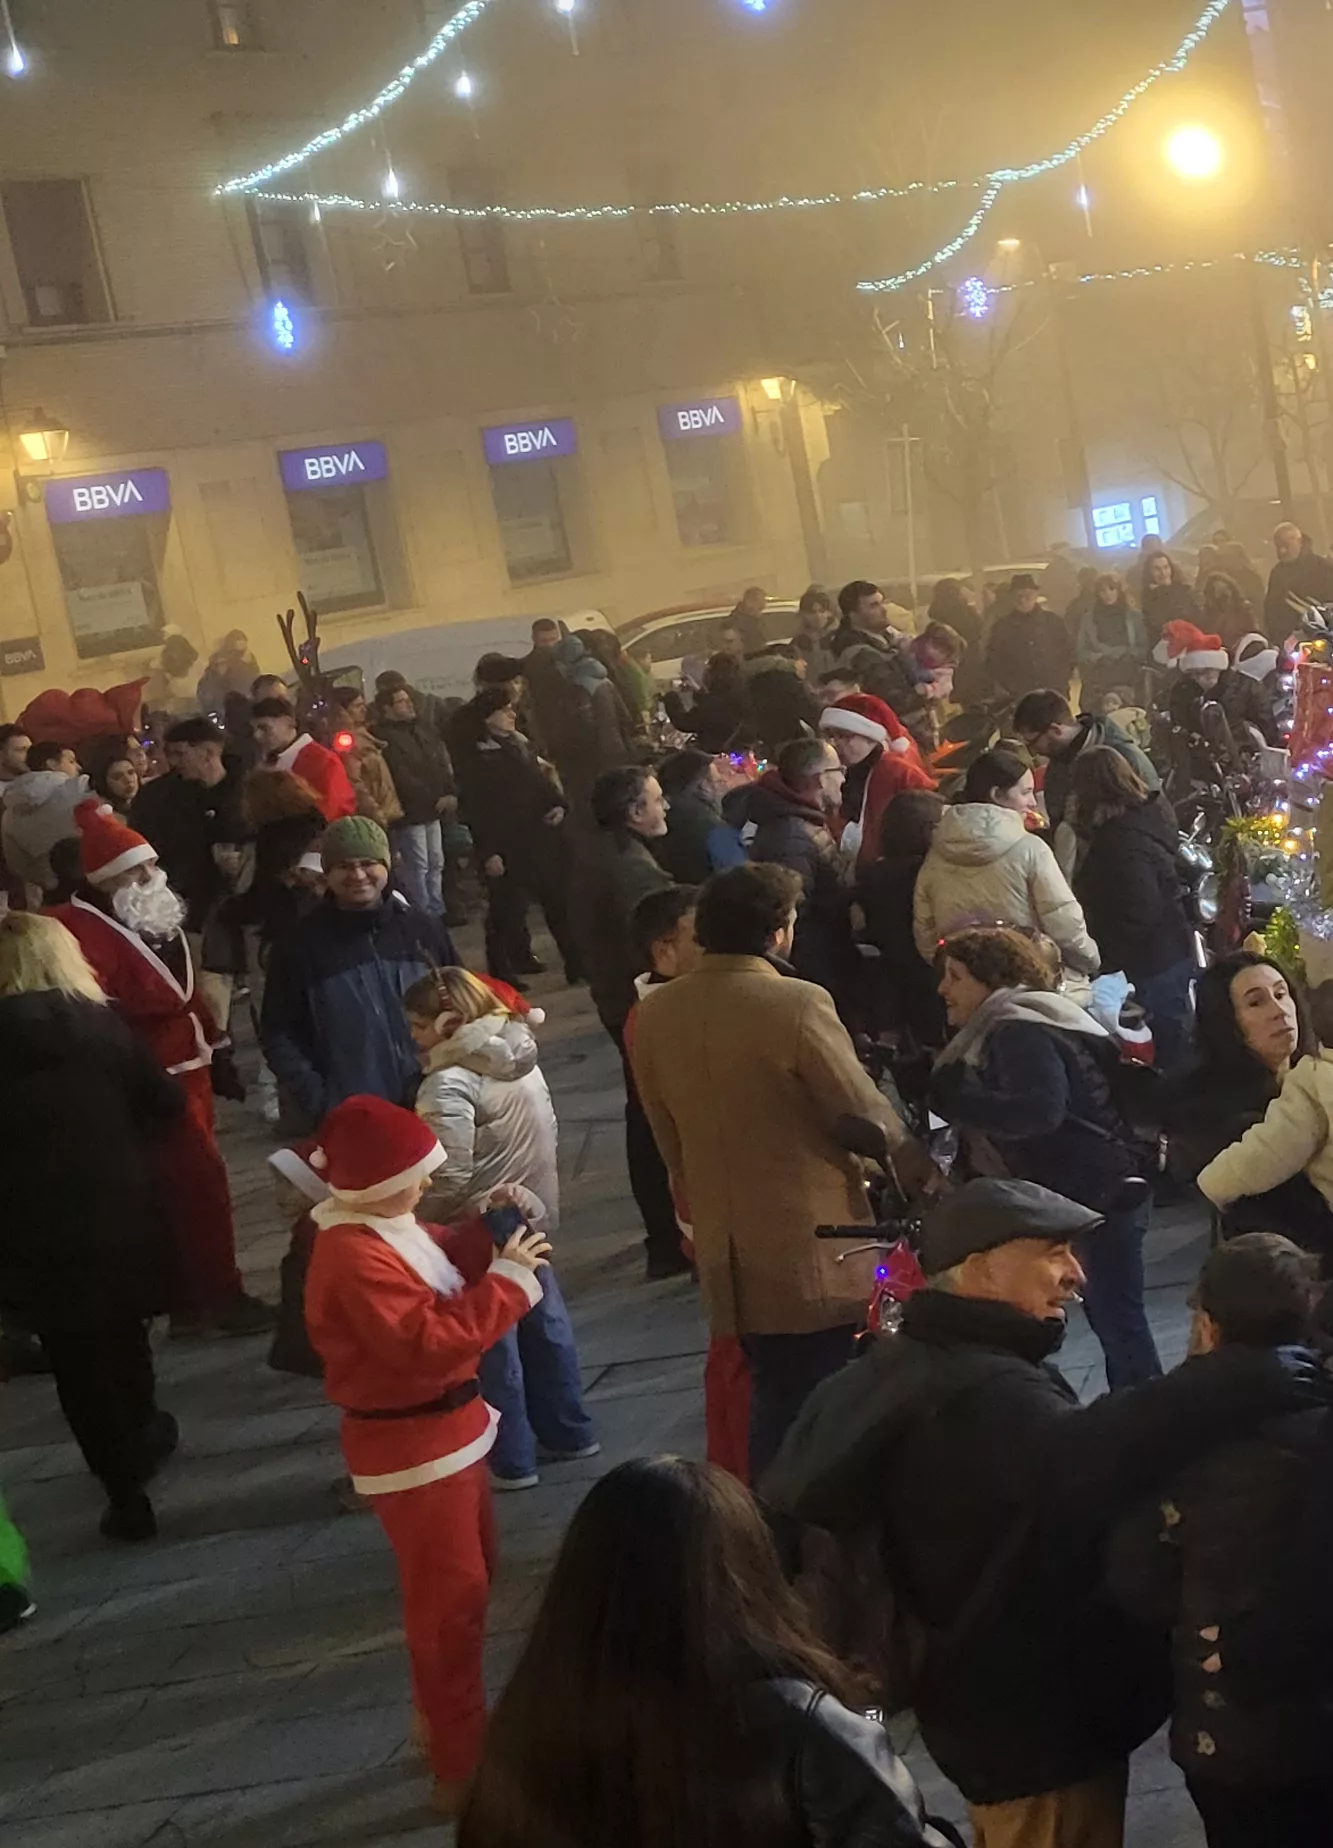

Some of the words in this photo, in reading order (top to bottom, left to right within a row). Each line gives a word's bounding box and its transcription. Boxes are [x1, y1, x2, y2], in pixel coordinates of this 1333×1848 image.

[676, 404, 725, 431] BBVA
[503, 426, 558, 455] BBVA
[304, 449, 366, 481] BBVA
[72, 479, 144, 512] BBVA
[4, 647, 38, 665] BBVA
